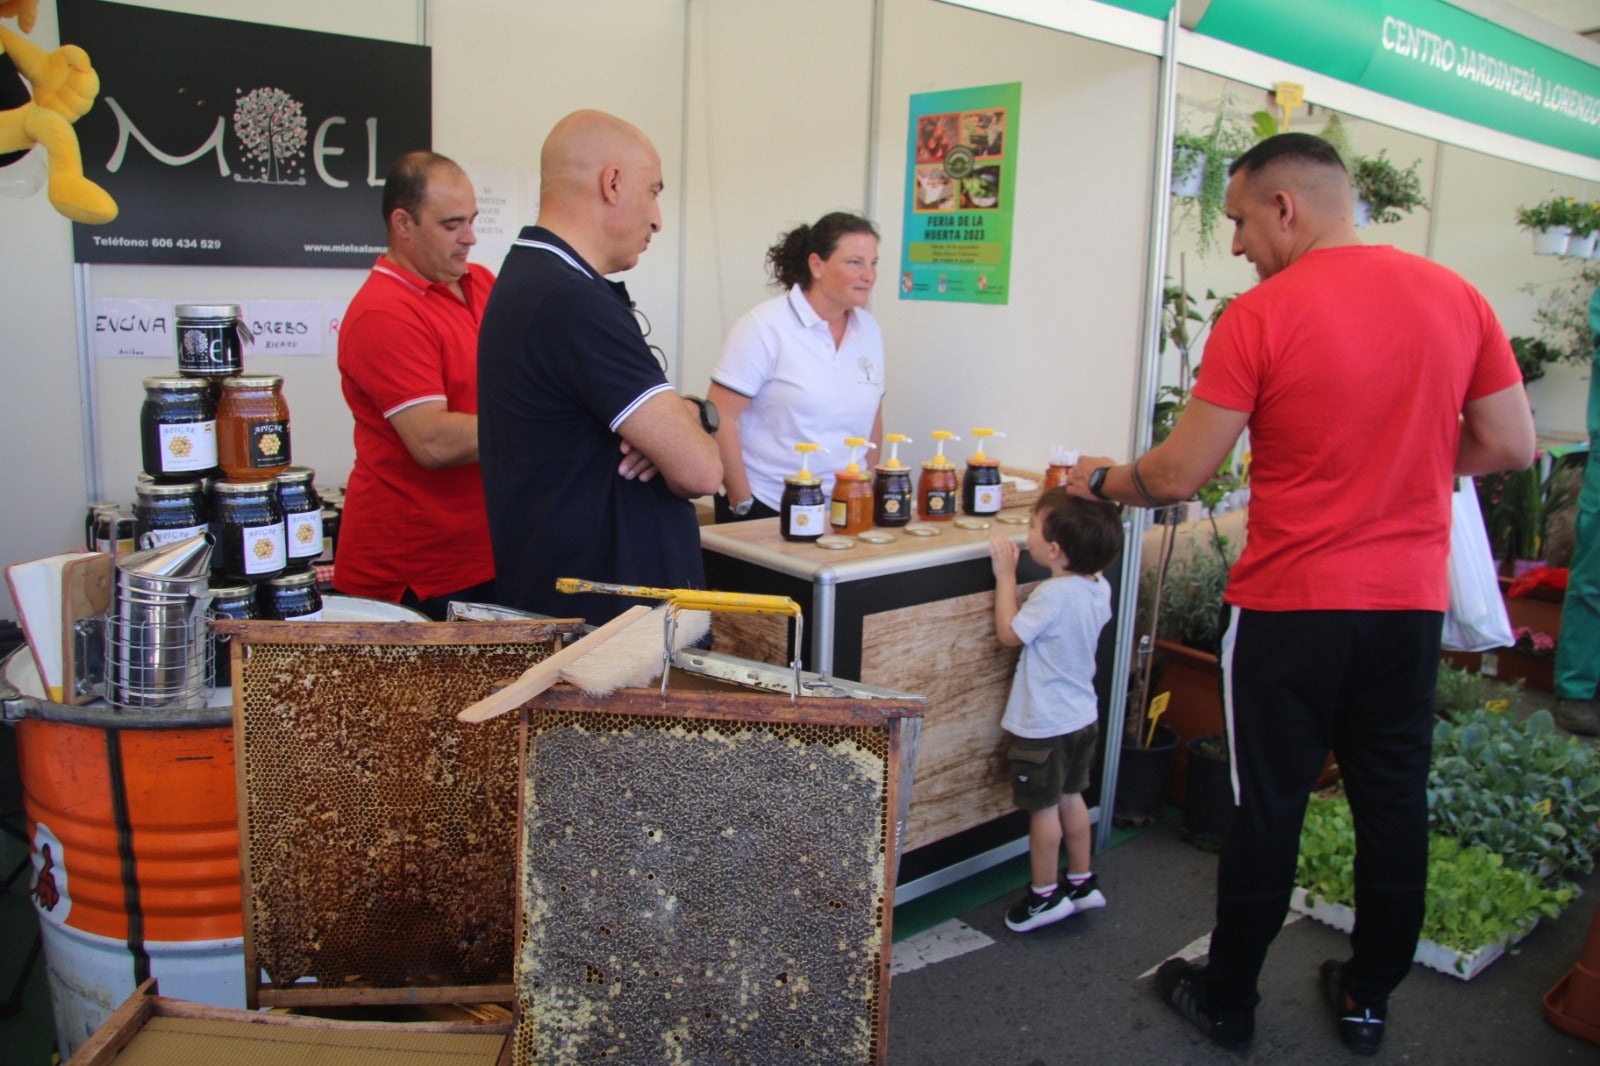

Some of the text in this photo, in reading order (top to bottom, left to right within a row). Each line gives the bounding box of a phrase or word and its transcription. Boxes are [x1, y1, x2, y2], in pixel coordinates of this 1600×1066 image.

[1381, 15, 1456, 72] CENTRO
[1456, 46, 1543, 104] JARDINERÍA
[927, 215, 983, 227] FERIA DE LA
[924, 229, 985, 240] HUERTA 2023
[92, 235, 222, 250] Teléfono: 606 434 529
[252, 423, 284, 435] APIGAR
